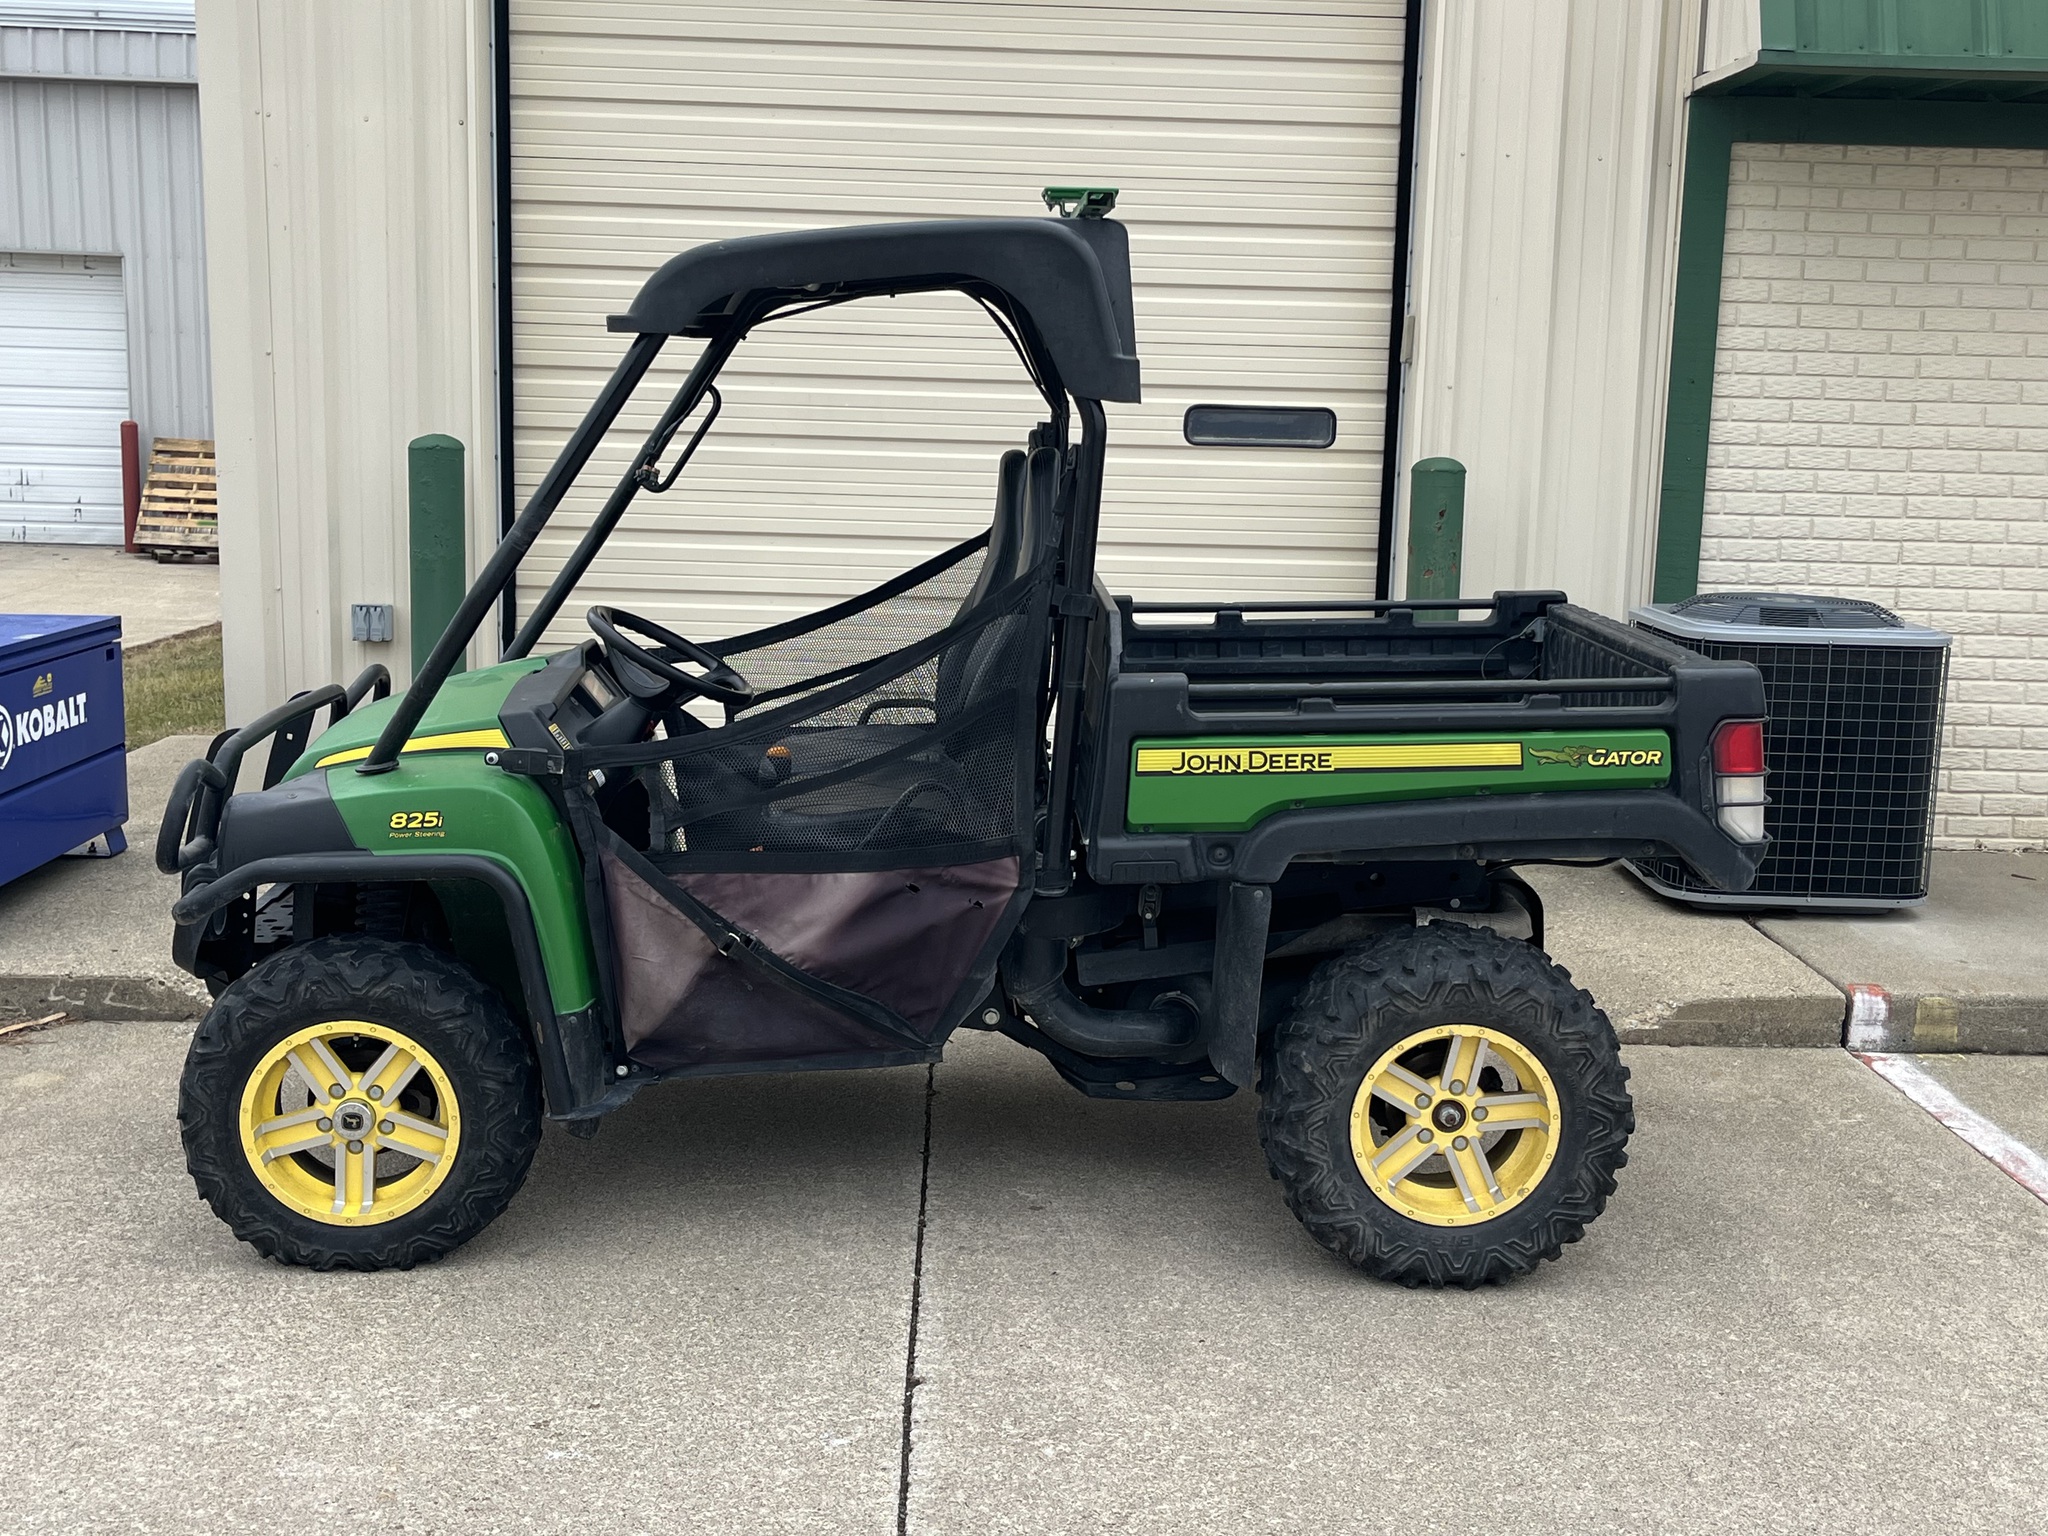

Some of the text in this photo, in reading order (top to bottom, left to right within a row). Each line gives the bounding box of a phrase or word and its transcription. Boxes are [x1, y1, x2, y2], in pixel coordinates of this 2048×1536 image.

[16, 692, 87, 747] KOBALT
[1171, 750, 1333, 772] JOHN DEERE
[1586, 749, 1663, 767] GATOR
[389, 811, 443, 829] 825i
